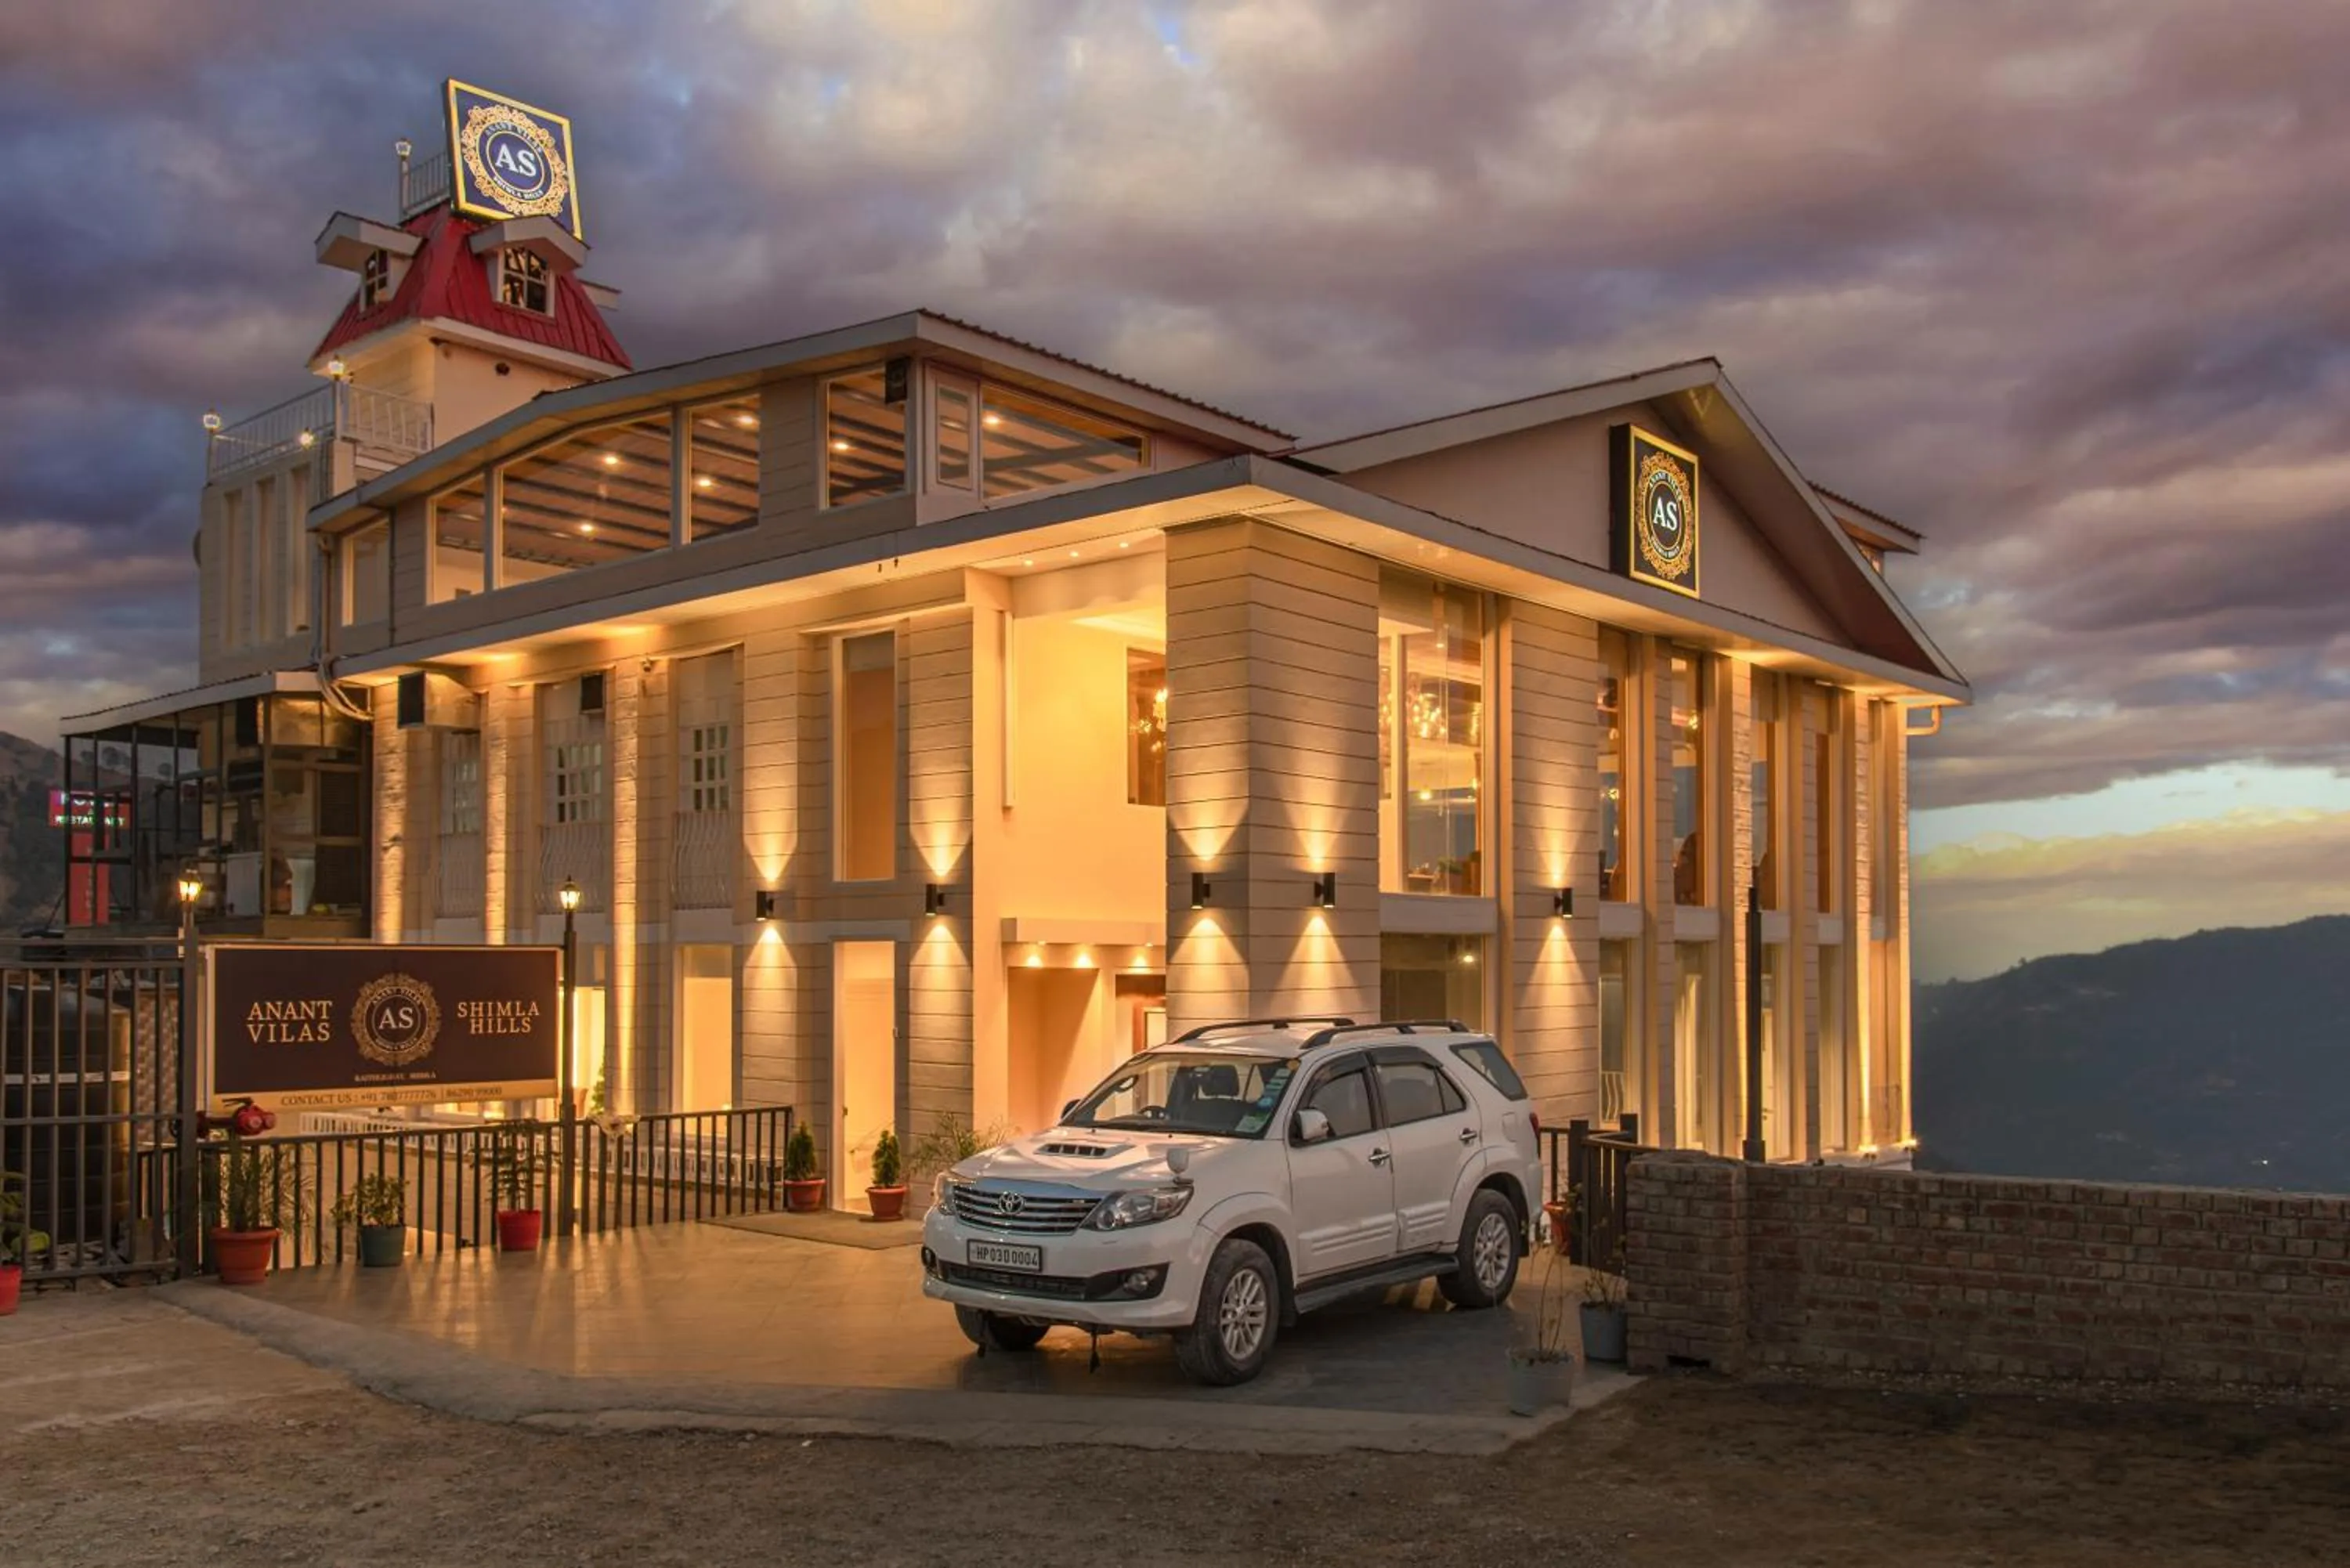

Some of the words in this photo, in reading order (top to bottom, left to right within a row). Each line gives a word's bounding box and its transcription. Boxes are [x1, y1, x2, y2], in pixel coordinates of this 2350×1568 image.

[495, 143, 536, 177] AS
[1654, 497, 1678, 531] AS
[248, 1000, 332, 1021] ANANT
[378, 1007, 414, 1029] AS
[457, 1001, 540, 1017] SHIMLA
[247, 1022, 331, 1043] VILAS
[470, 1017, 532, 1035] HILLS
[280, 1093, 334, 1105] CONTACT
[337, 1093, 352, 1104] US
